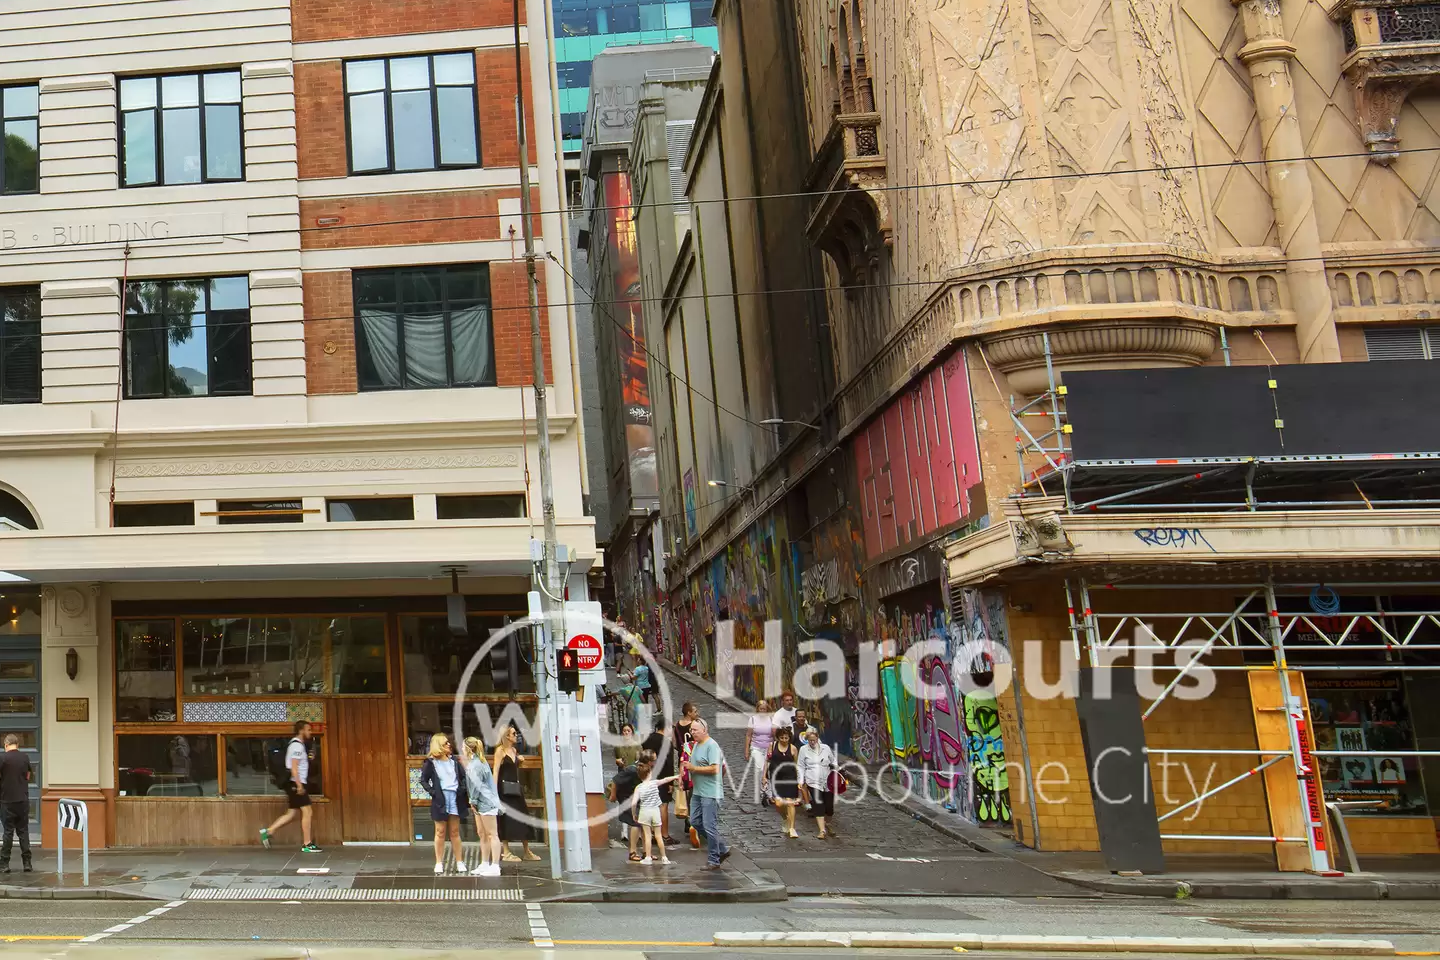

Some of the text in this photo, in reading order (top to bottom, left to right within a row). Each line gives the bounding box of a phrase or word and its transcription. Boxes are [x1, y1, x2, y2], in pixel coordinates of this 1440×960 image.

[53, 220, 170, 246] BUILDING
[578, 640, 590, 648] NO
[577, 656, 598, 664] NTRY
[1298, 728, 1312, 768] ACCESS
